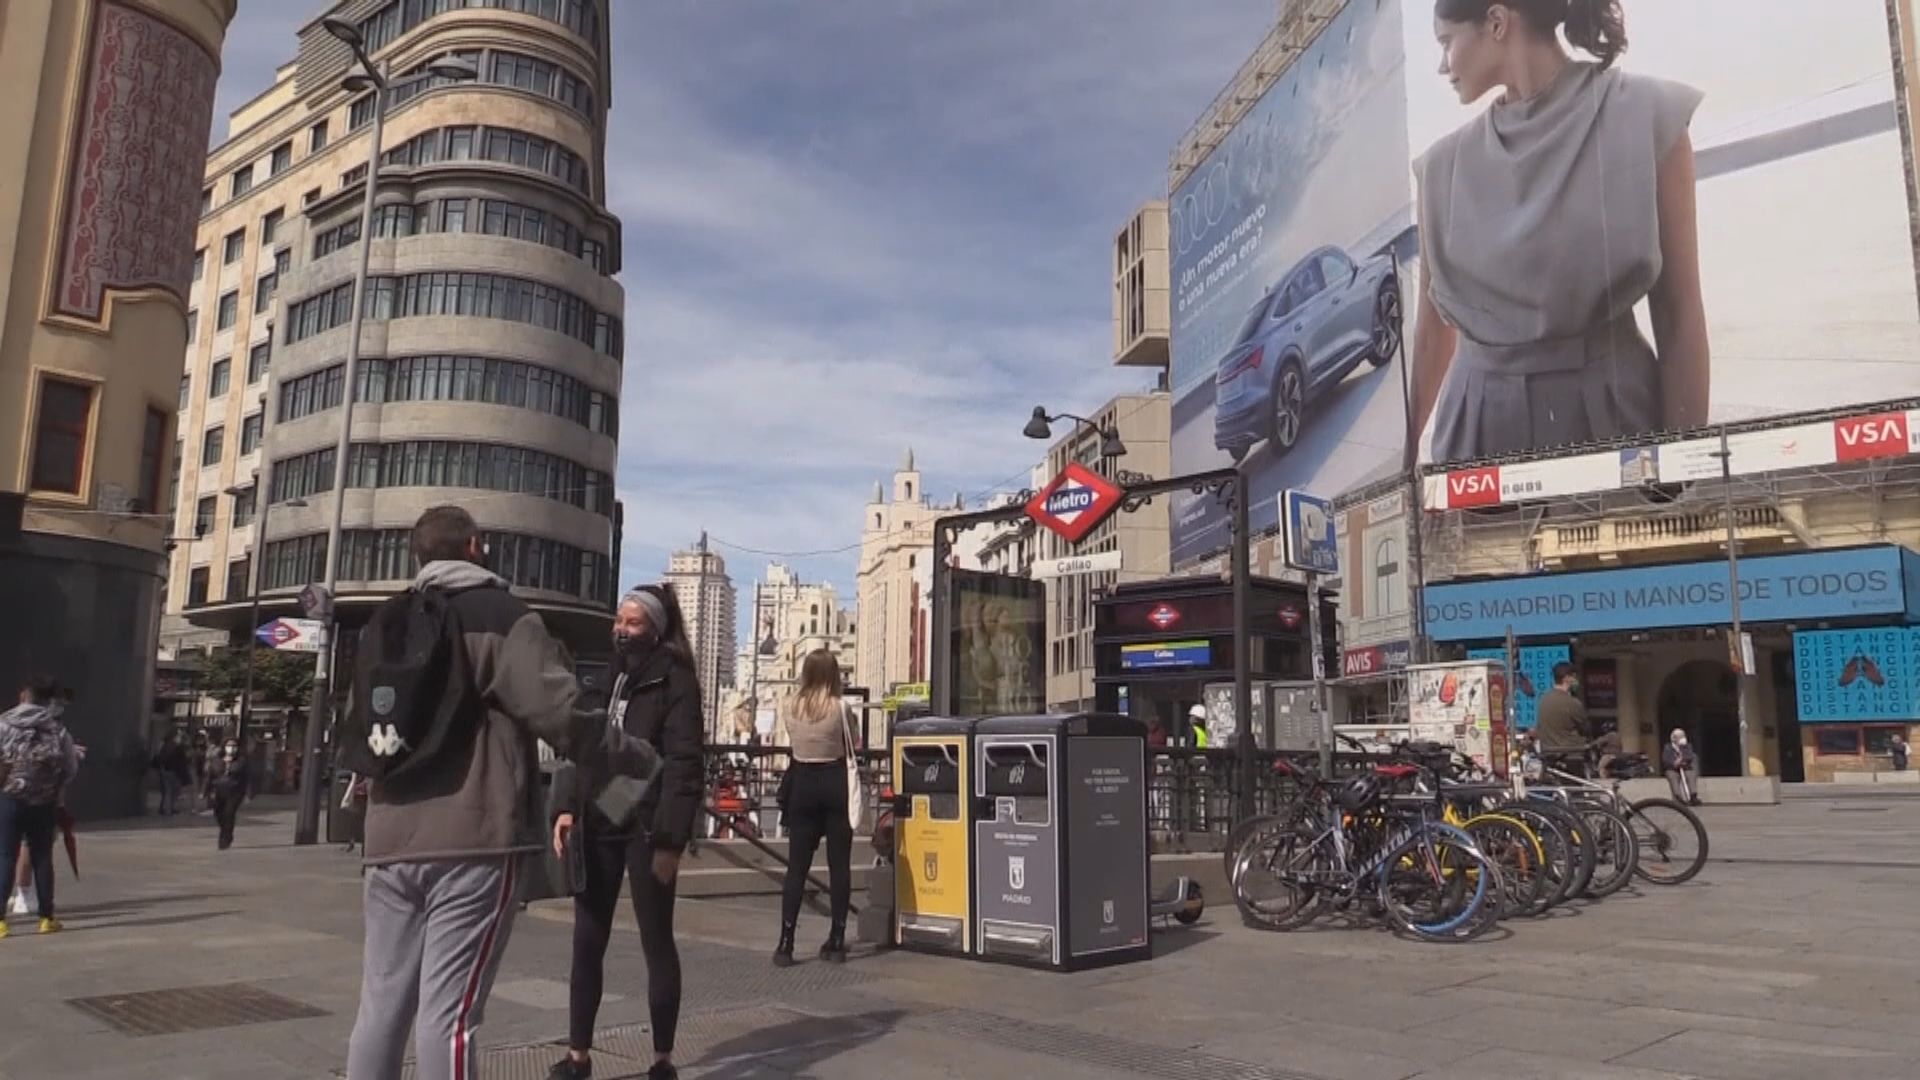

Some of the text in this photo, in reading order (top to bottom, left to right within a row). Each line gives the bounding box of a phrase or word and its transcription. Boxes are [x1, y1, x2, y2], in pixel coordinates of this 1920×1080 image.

[1197, 235, 1230, 274] motor
[1231, 204, 1266, 242] nuevo
[1179, 299, 1185, 311] o
[1187, 282, 1204, 305] una
[1206, 254, 1237, 288] nueva
[1239, 225, 1263, 259] era?
[1840, 420, 1902, 446] VSA
[1451, 474, 1495, 495] VSA
[1049, 492, 1089, 511] Metro
[1057, 560, 1092, 573] Callao
[1426, 570, 1887, 623] DOS MADRID EN MANOS DE TODOS
[1346, 652, 1372, 673] AVIS
